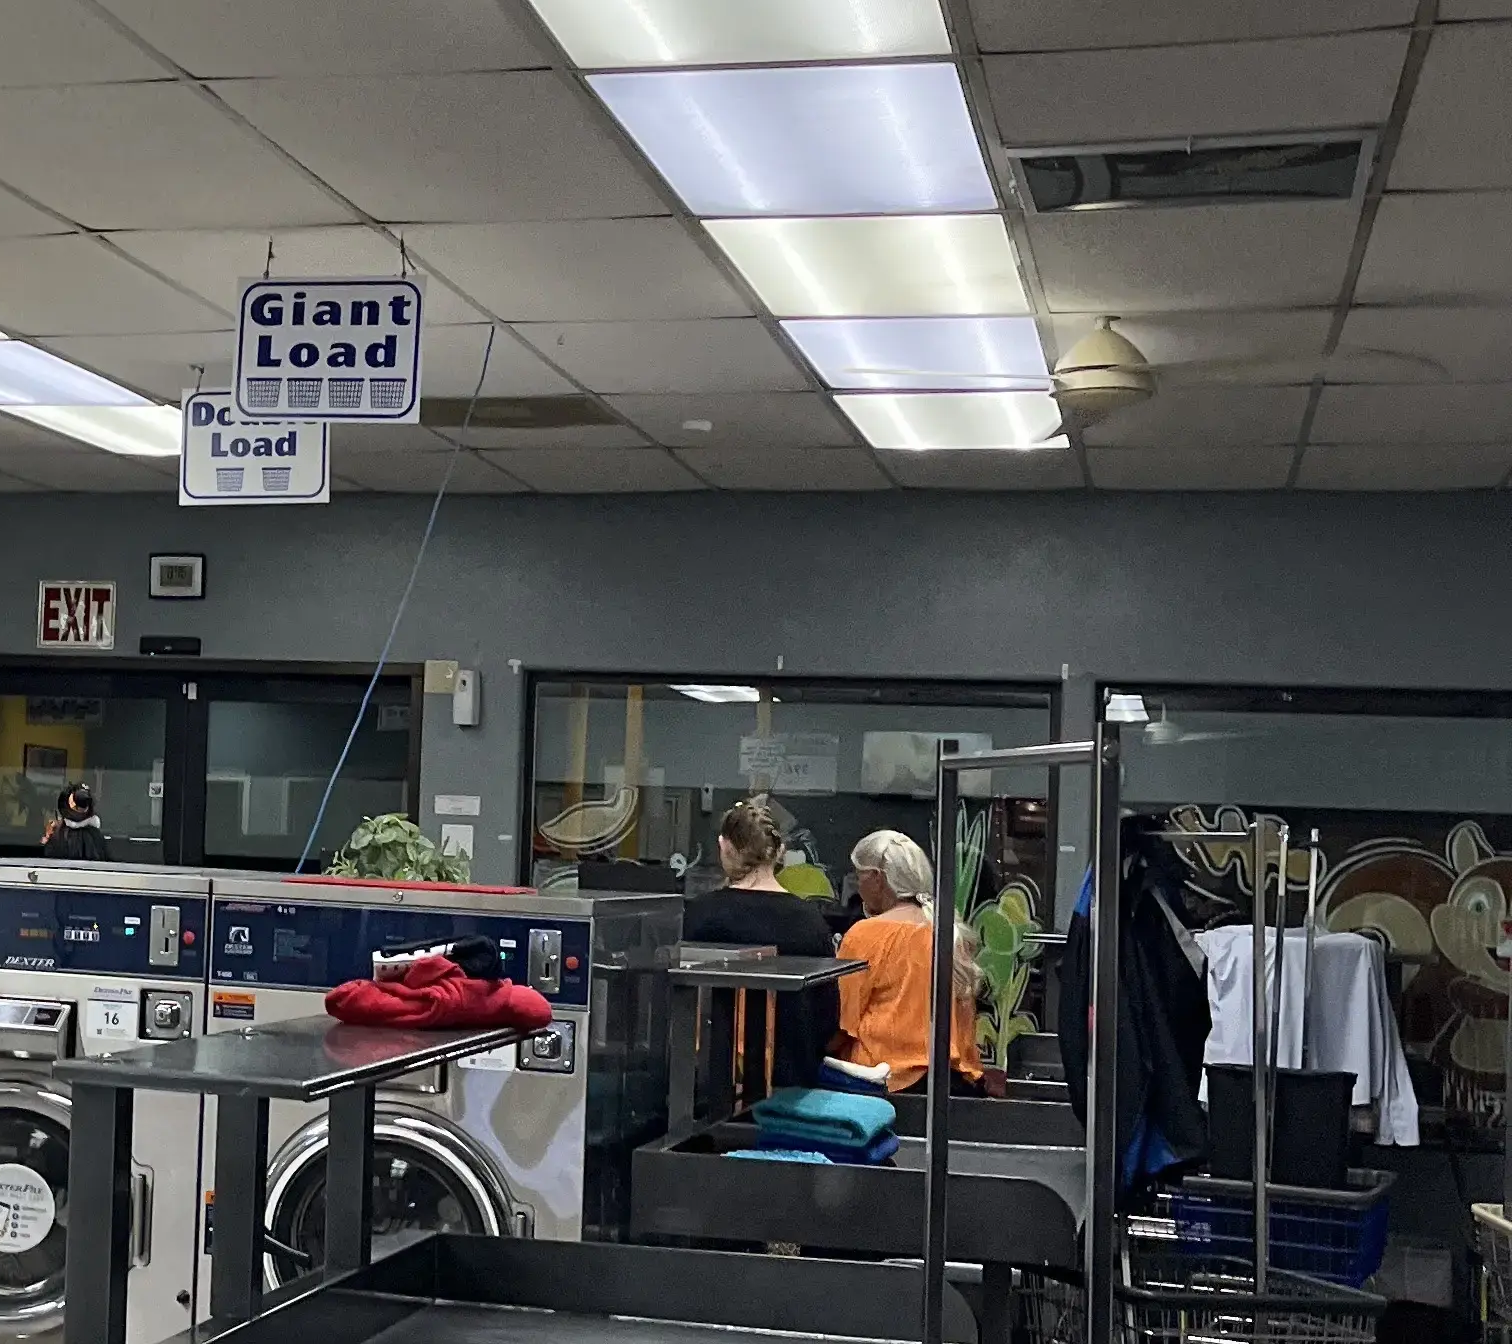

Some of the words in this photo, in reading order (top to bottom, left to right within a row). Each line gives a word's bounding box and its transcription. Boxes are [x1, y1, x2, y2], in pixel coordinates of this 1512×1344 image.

[250, 291, 411, 326] Giant
[256, 334, 397, 368] Load
[211, 431, 297, 457] Load
[42, 587, 111, 642] EXIT
[3, 955, 56, 968] DEXTER
[104, 1011, 120, 1026] 16
